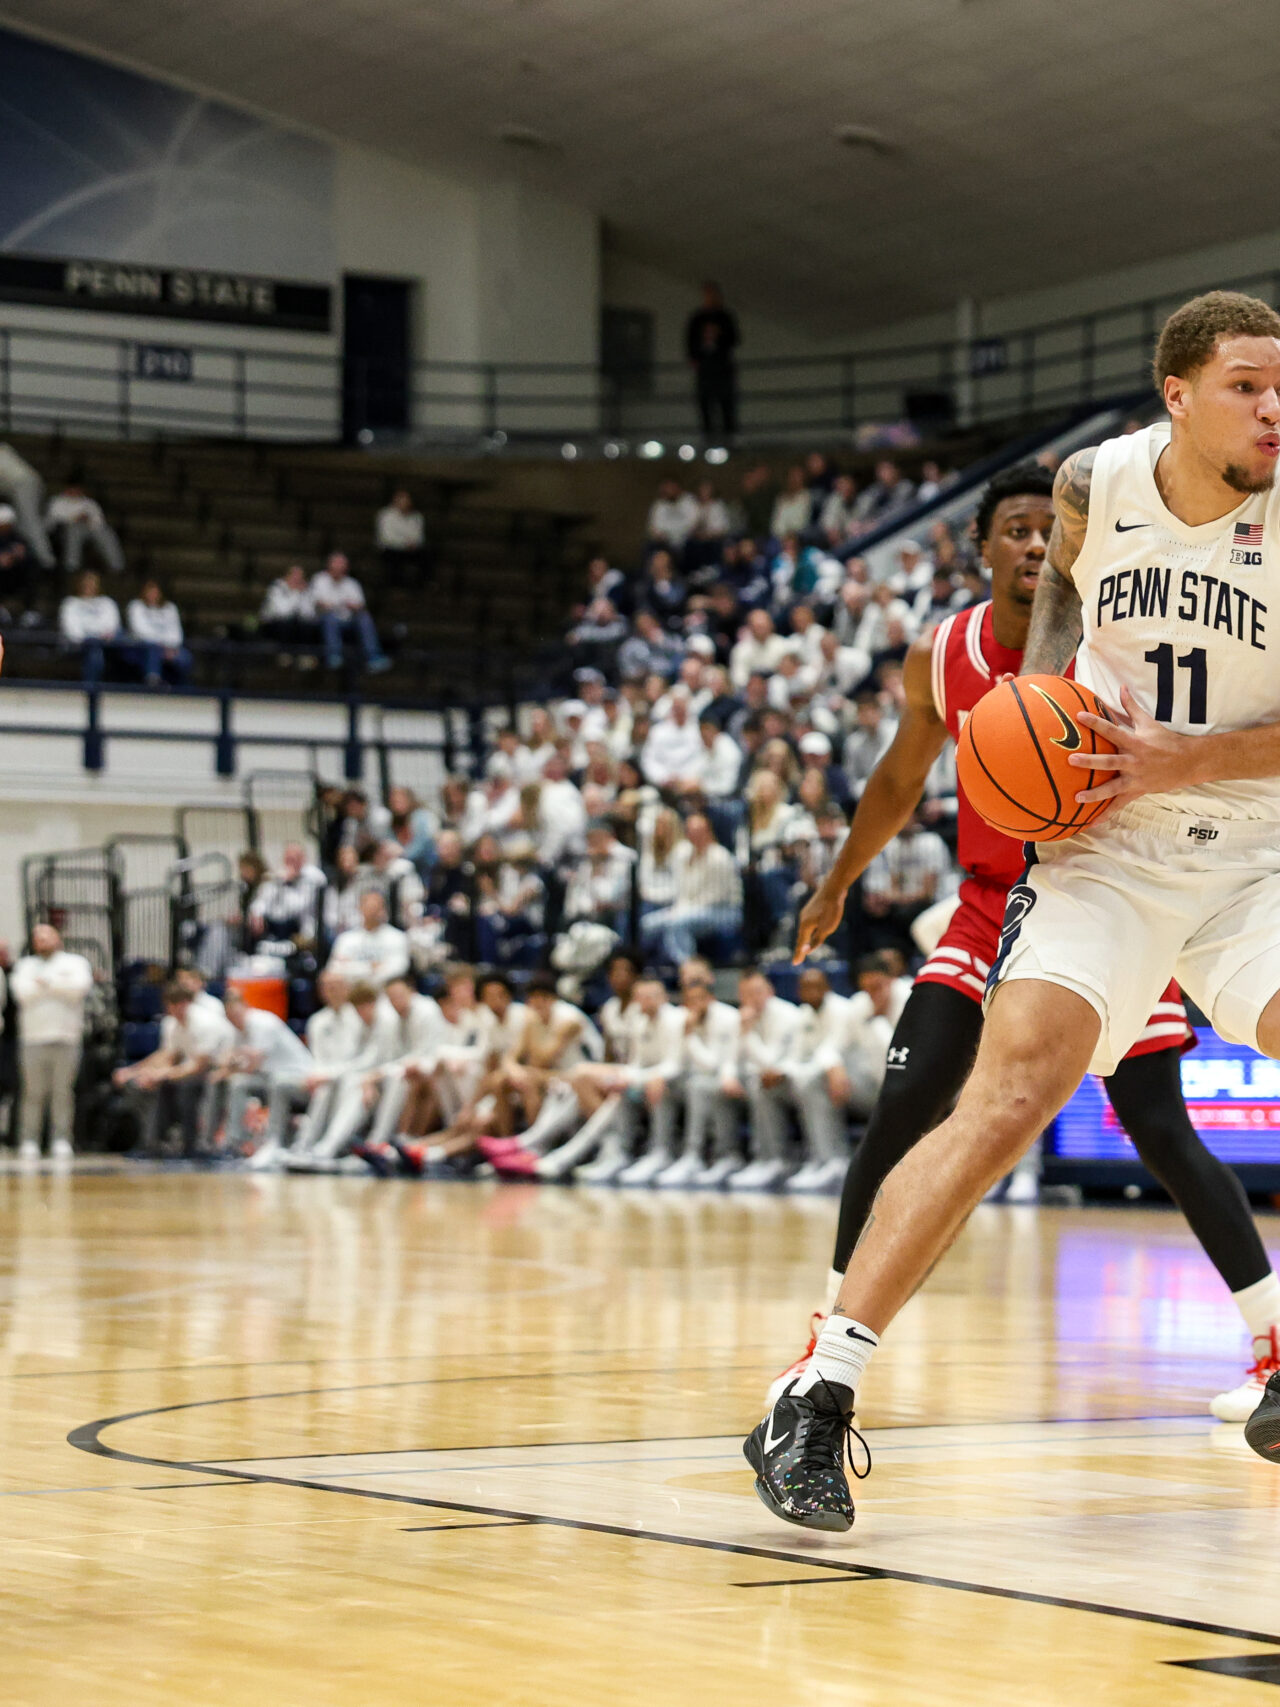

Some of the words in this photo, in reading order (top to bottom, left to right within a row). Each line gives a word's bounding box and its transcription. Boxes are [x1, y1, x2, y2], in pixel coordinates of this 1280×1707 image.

[67, 262, 161, 299] PENN
[173, 273, 275, 313] STATE
[1097, 567, 1172, 628] PENN
[1178, 571, 1268, 650] STATE
[1144, 642, 1208, 725] 11
[1187, 826, 1219, 840] PSU
